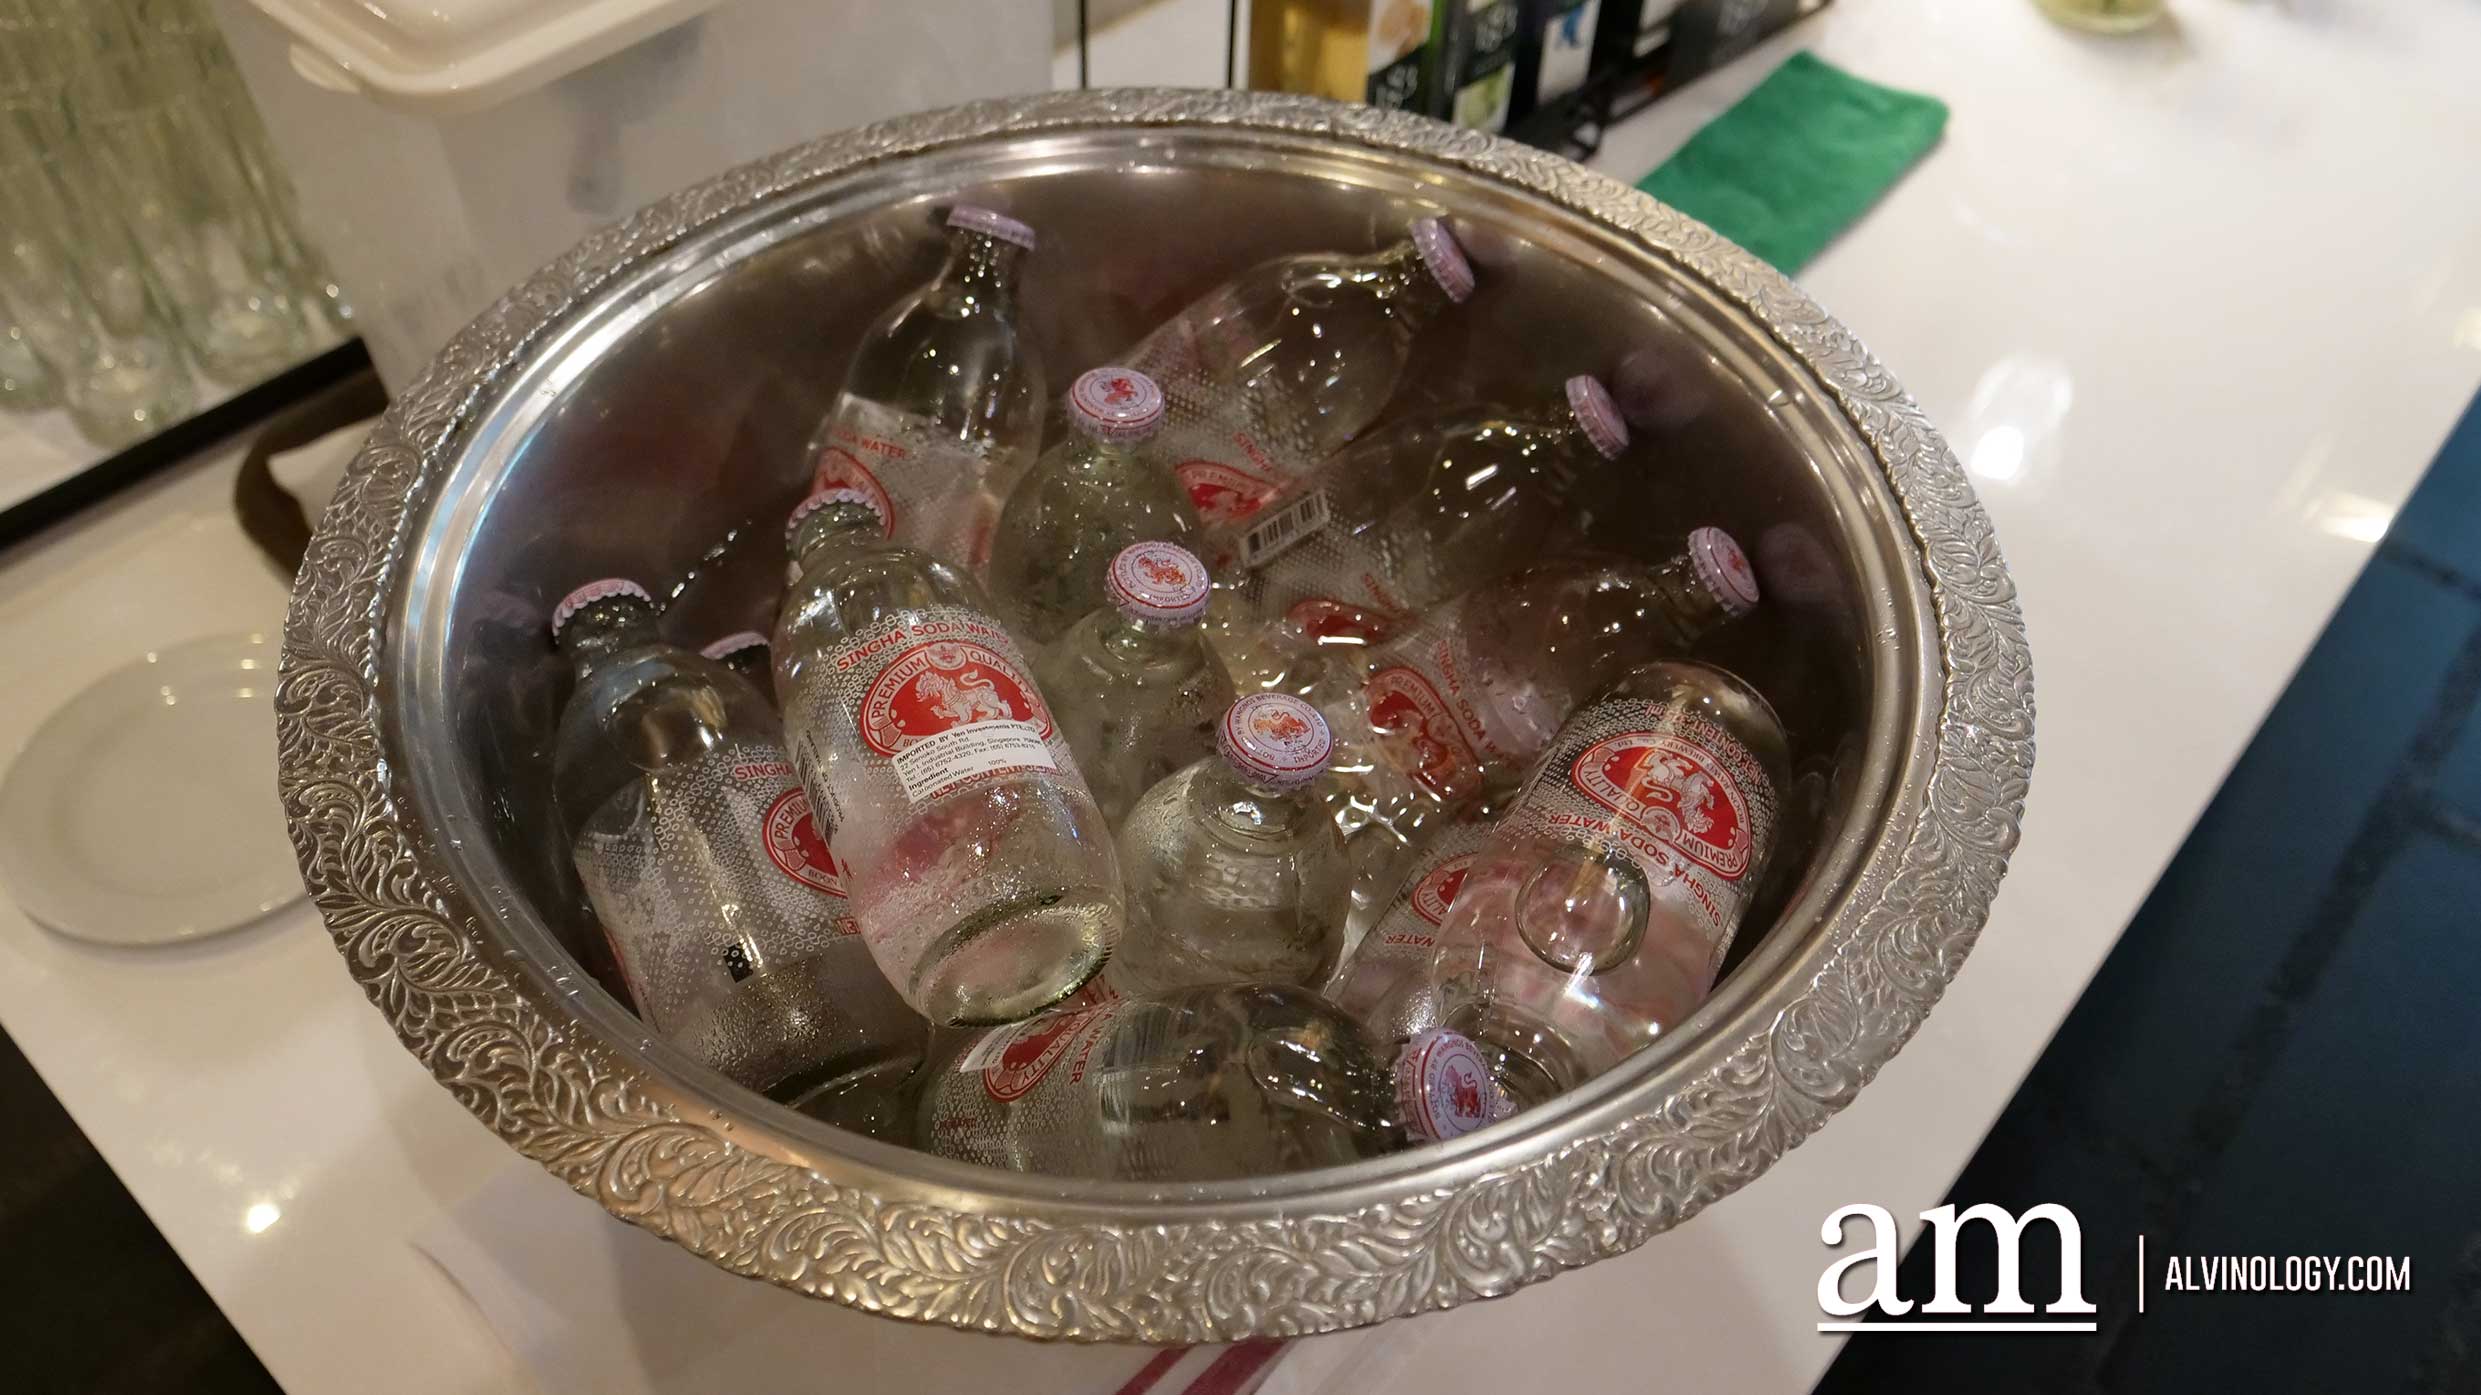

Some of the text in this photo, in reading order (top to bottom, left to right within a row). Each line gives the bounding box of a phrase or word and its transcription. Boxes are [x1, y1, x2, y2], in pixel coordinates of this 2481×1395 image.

[837, 630, 907, 673] SINGHA
[911, 622, 962, 637] SODA
[871, 650, 1032, 719] PREMIUM QUALITY
[1437, 639, 1486, 740] SINGHA SODA
[896, 740, 936, 764] IMPORTED
[939, 735, 949, 744] BY
[1691, 717, 1743, 764] CONTENT
[735, 762, 792, 781] SINGHA
[909, 767, 949, 791] Ingredient
[1682, 832, 1738, 868] PREMIUM
[1620, 828, 1669, 866] SODA
[1672, 863, 1721, 927] SINGHA
[1069, 1027, 1101, 1085] WATER
